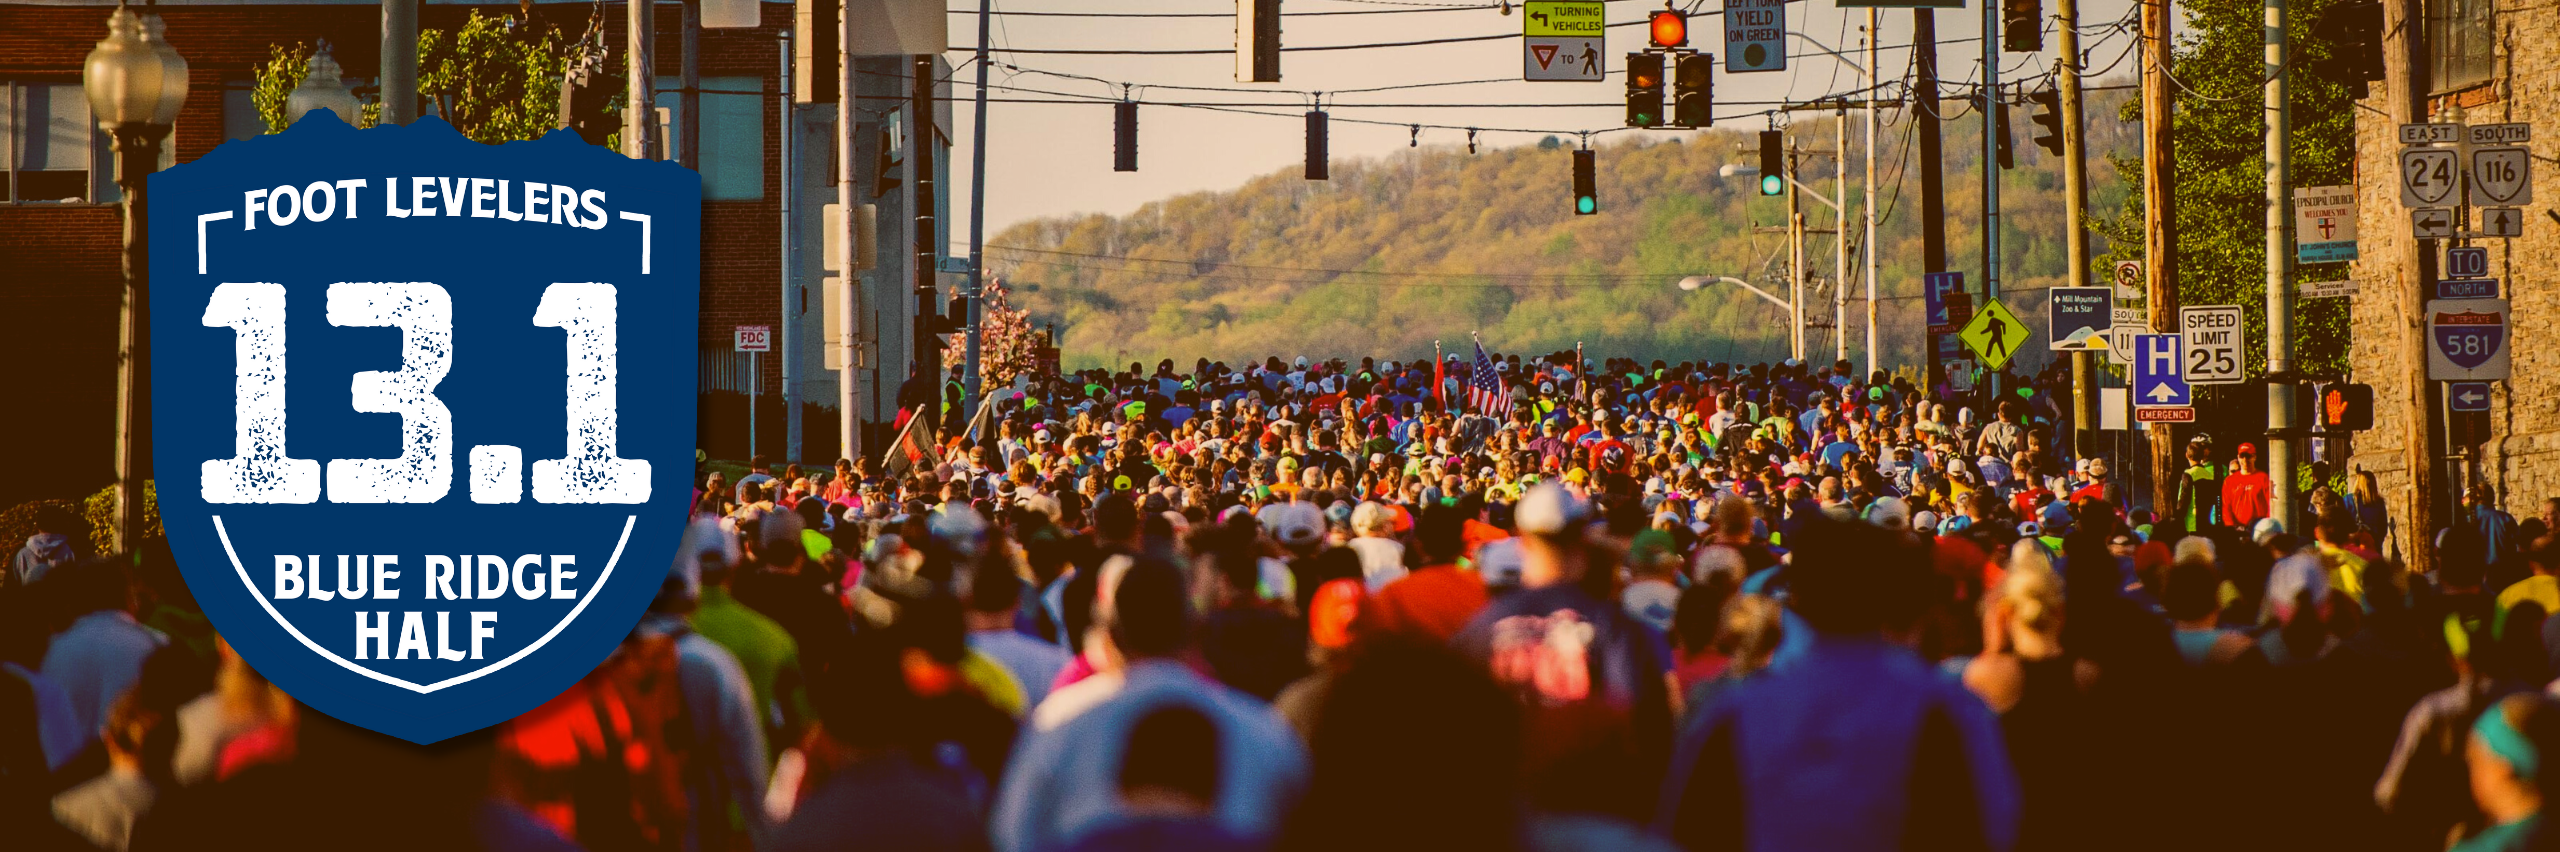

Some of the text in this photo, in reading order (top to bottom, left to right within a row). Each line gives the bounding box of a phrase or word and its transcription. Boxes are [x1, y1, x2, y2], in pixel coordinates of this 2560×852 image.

[1554, 7, 1600, 16] TURNING
[1736, 10, 1774, 26] YIELD
[1552, 21, 1601, 31] VEHICLES
[1729, 28, 1780, 42] ON GREEN
[1561, 55, 1574, 64] TO
[2407, 127, 2451, 140] EAST
[2474, 126, 2526, 140] SOUTH
[2411, 158, 2450, 187] 24
[2486, 160, 2516, 183] 116
[2297, 194, 2354, 208] EPISCOPAL CHURCH
[2304, 208, 2348, 218] WELCOMES YOU
[2453, 251, 2481, 273] TO
[2450, 283, 2486, 295] NORTH
[2062, 295, 2103, 304] Mill Mountain
[2062, 305, 2093, 313] Zoo & Star
[2187, 314, 2236, 328] SPEED
[2448, 315, 2491, 324] INTERSTATE
[1930, 324, 1959, 334] EMERGEN
[740, 332, 764, 343] FDC
[2120, 333, 2134, 350] 11
[2193, 331, 2231, 345] LIMIT
[2447, 334, 2489, 355] 581
[2149, 337, 2176, 376] H
[2189, 348, 2236, 375] 25
[2140, 410, 2190, 420] EMERGENCY
